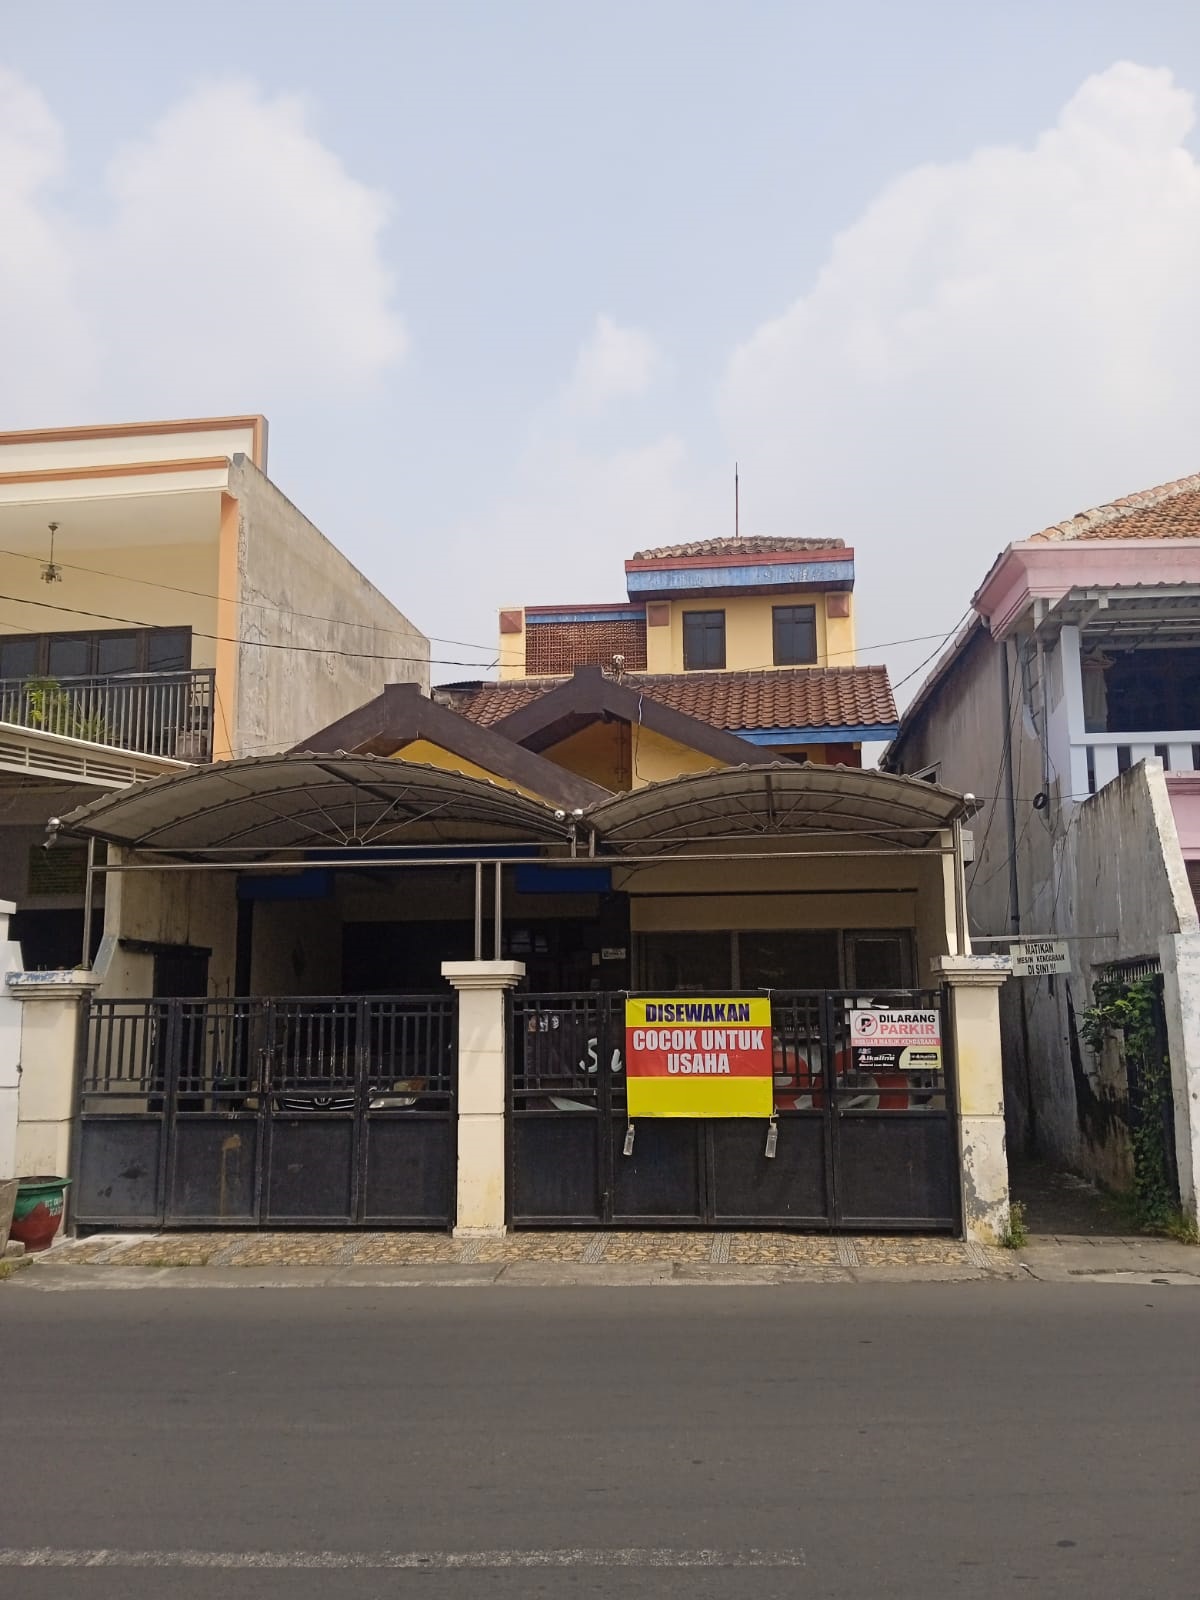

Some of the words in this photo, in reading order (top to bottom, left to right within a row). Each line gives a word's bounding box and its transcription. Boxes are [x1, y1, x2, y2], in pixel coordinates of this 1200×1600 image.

[1025, 943, 1053, 955] MATIKAN
[1017, 956, 1033, 964] MESIN
[1028, 964, 1035, 975] DI
[1036, 963, 1049, 974] SINI
[645, 1004, 750, 1022] DISEWAKAN
[879, 1014, 936, 1023] DILARANG
[879, 1024, 936, 1035] PARKIR
[633, 1030, 697, 1051] COCOK
[701, 1029, 765, 1050] UNTUK
[667, 1053, 731, 1074] USAHA
